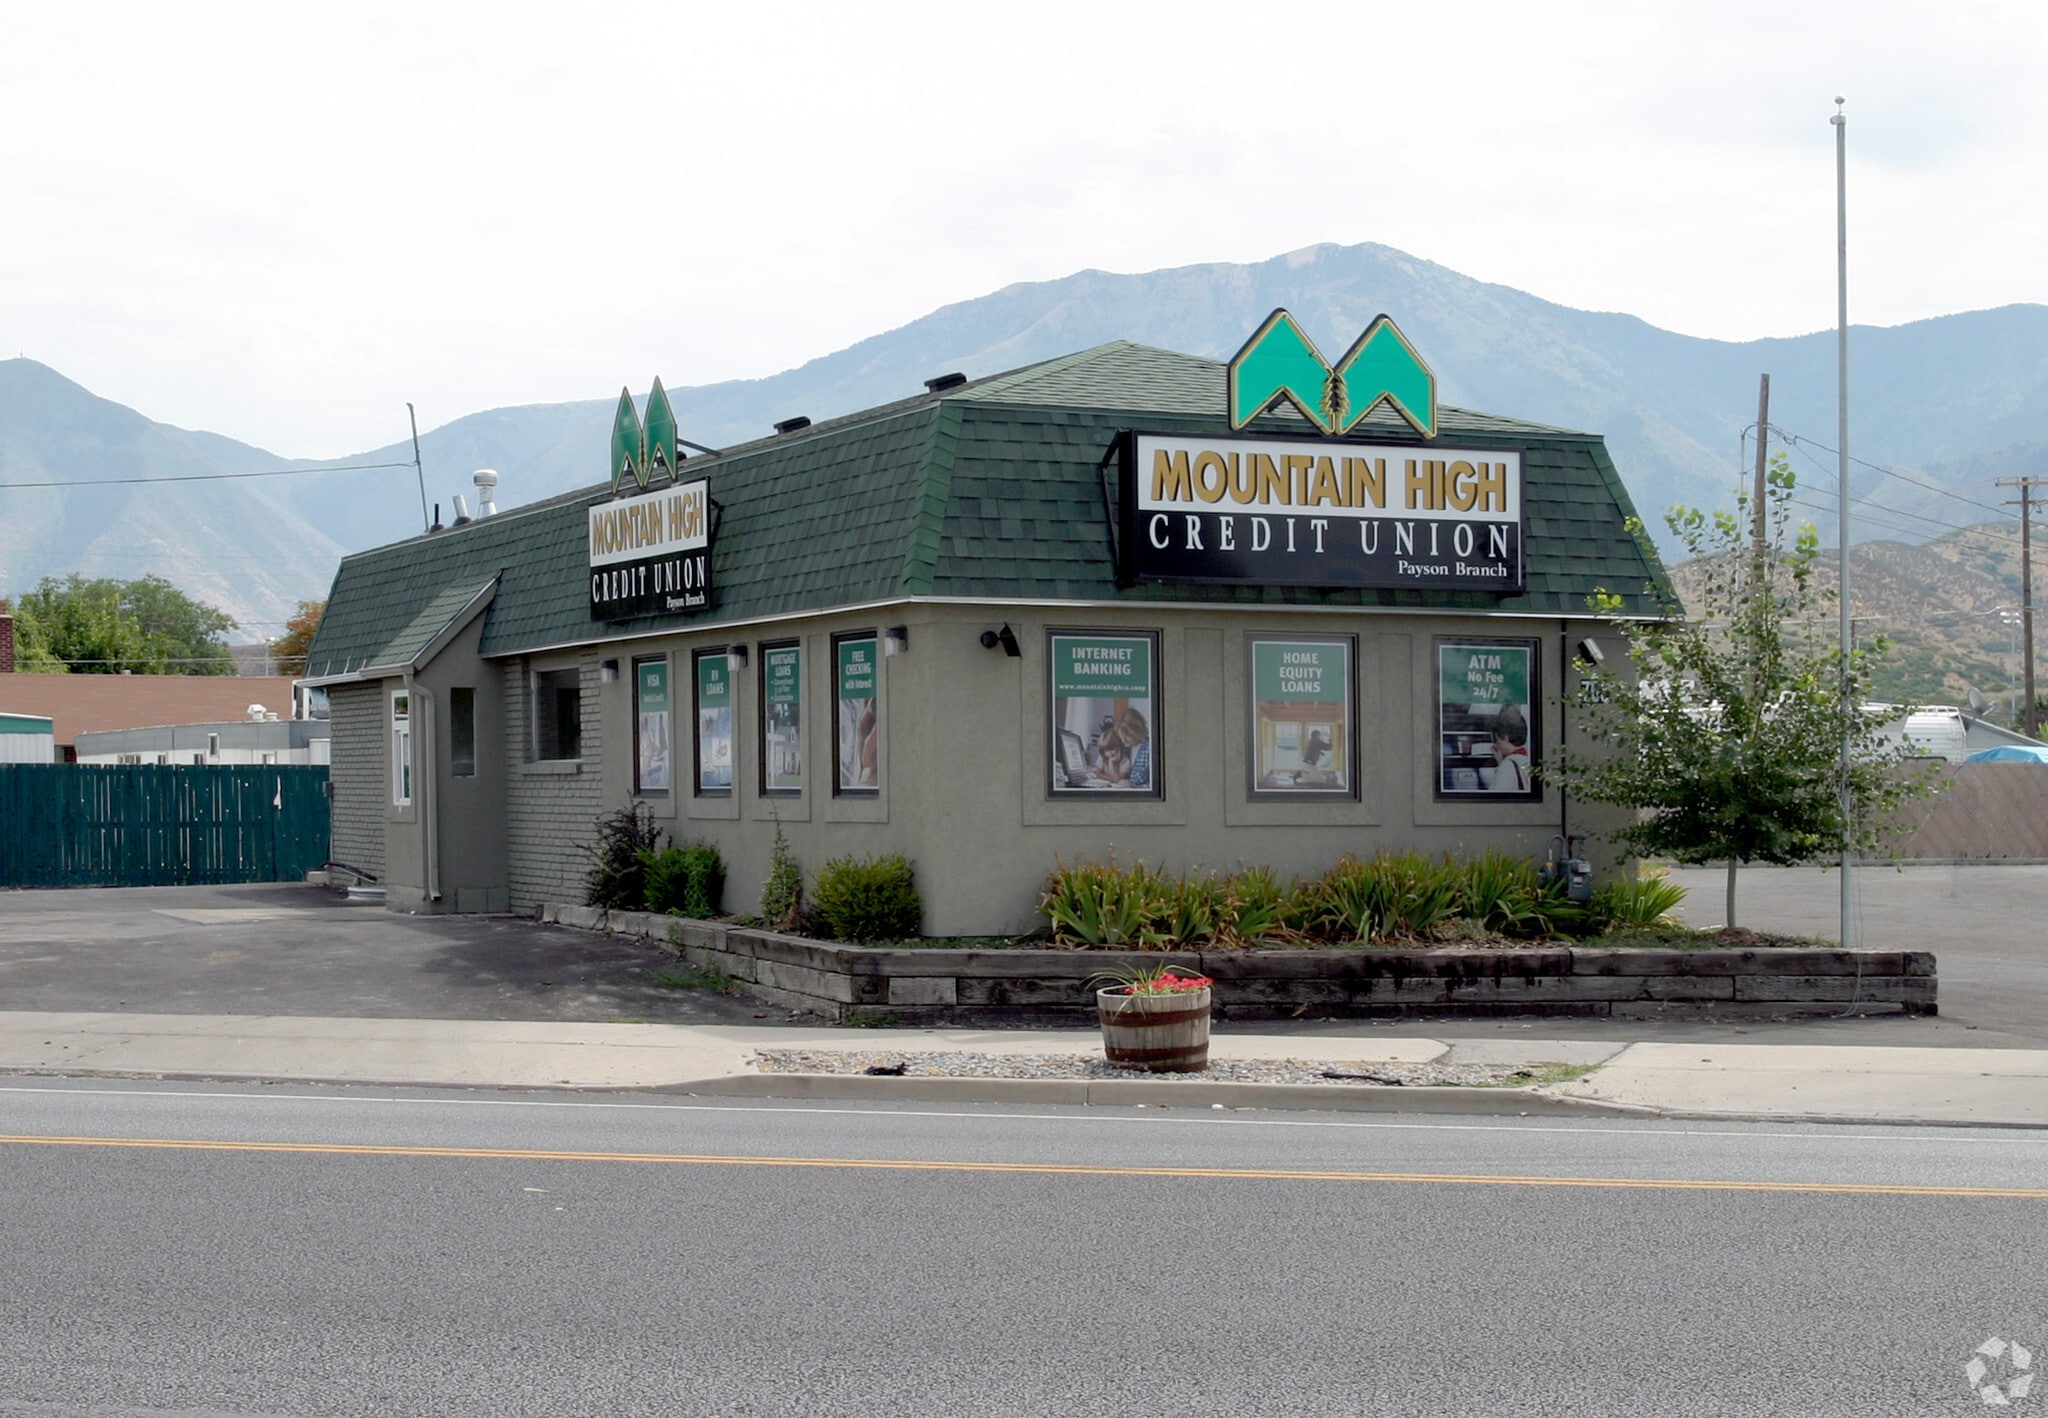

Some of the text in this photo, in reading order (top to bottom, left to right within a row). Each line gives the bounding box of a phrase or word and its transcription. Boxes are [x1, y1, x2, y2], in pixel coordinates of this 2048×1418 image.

[1151, 449, 1507, 512] MOUNTAIN HIGH
[592, 490, 704, 556] MOUNTAIN HIGH
[1149, 513, 1509, 559] CREDIT UNION
[1398, 560, 1508, 579] Payson Branch
[592, 556, 705, 603] CREDIT UNION
[1072, 647, 1133, 660] INTERNET
[1283, 652, 1319, 664] HOME
[1074, 662, 1131, 675] BANKING
[1468, 654, 1501, 670] ATM
[1279, 667, 1323, 679] EQUITY
[1467, 671, 1504, 683] No Fee
[646, 674, 660, 687] VISA
[1282, 681, 1321, 693] LOANS
[706, 682, 724, 696] LOANS
[1472, 687, 1499, 699] 24/7
